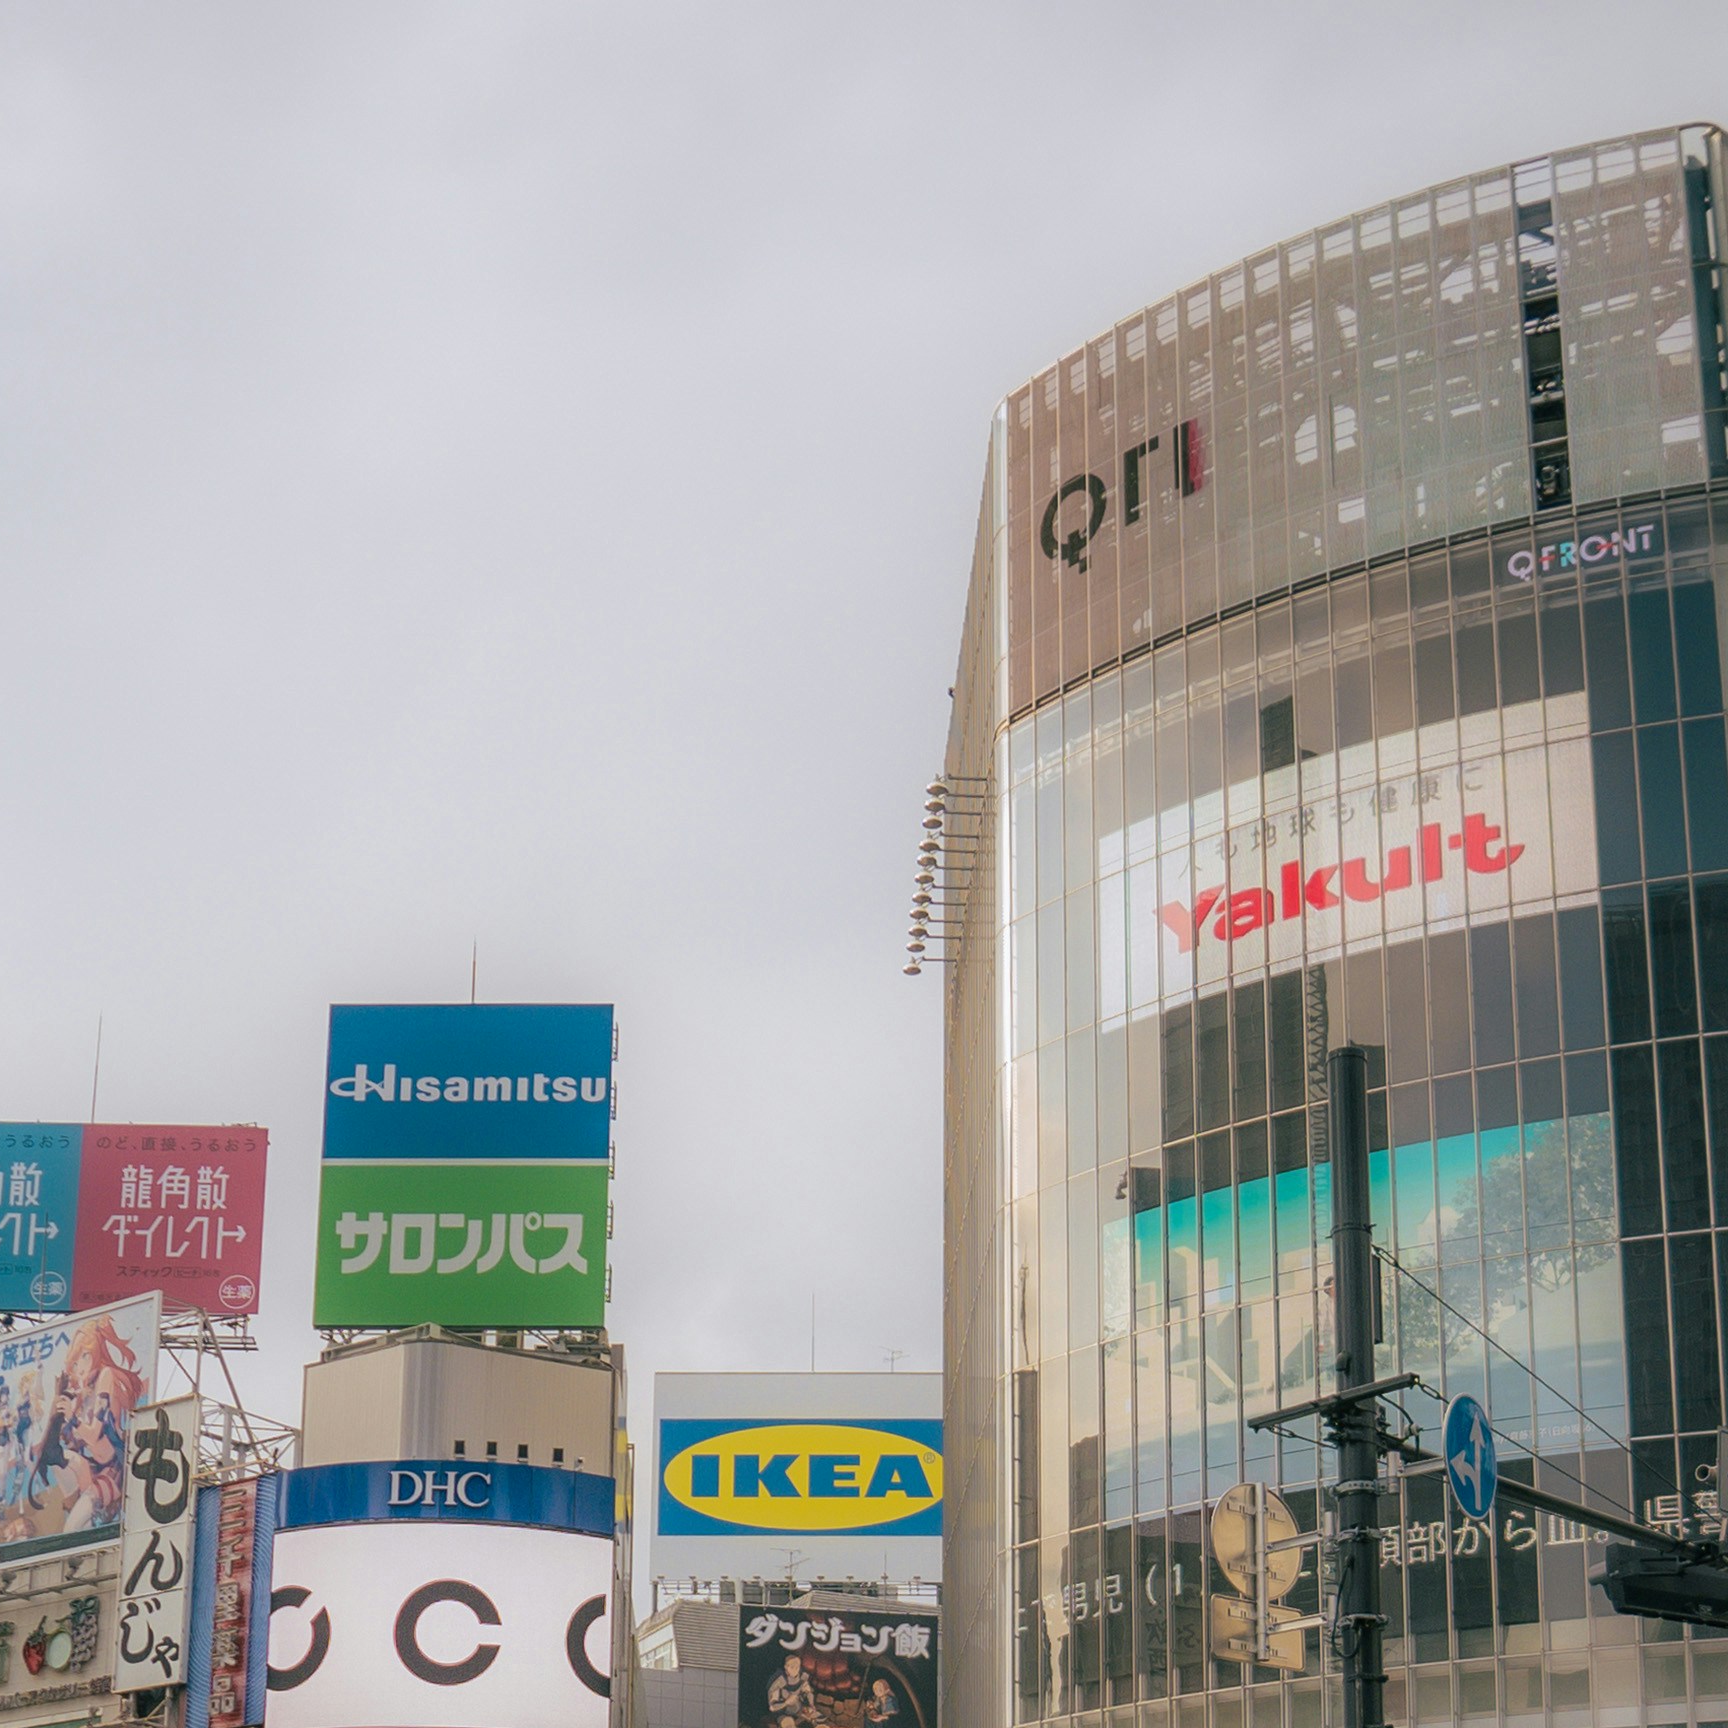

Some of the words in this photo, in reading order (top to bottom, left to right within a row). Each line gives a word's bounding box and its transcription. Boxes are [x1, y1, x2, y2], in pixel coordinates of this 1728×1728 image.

[1152, 812, 1524, 953] Yakult
[330, 1064, 607, 1102] Hisamitsu
[96, 1136, 257, 1153] のど、直接、うるおう
[120, 1164, 230, 1210] 龍角散
[102, 1214, 248, 1259] ダイレクト
[335, 1211, 589, 1275] サロンパス
[388, 1470, 491, 1507] DHC
[691, 1454, 934, 1498] IKEA
[120, 1407, 190, 1679] もんじゃ
[746, 1613, 932, 1659] ダンジョン飯
